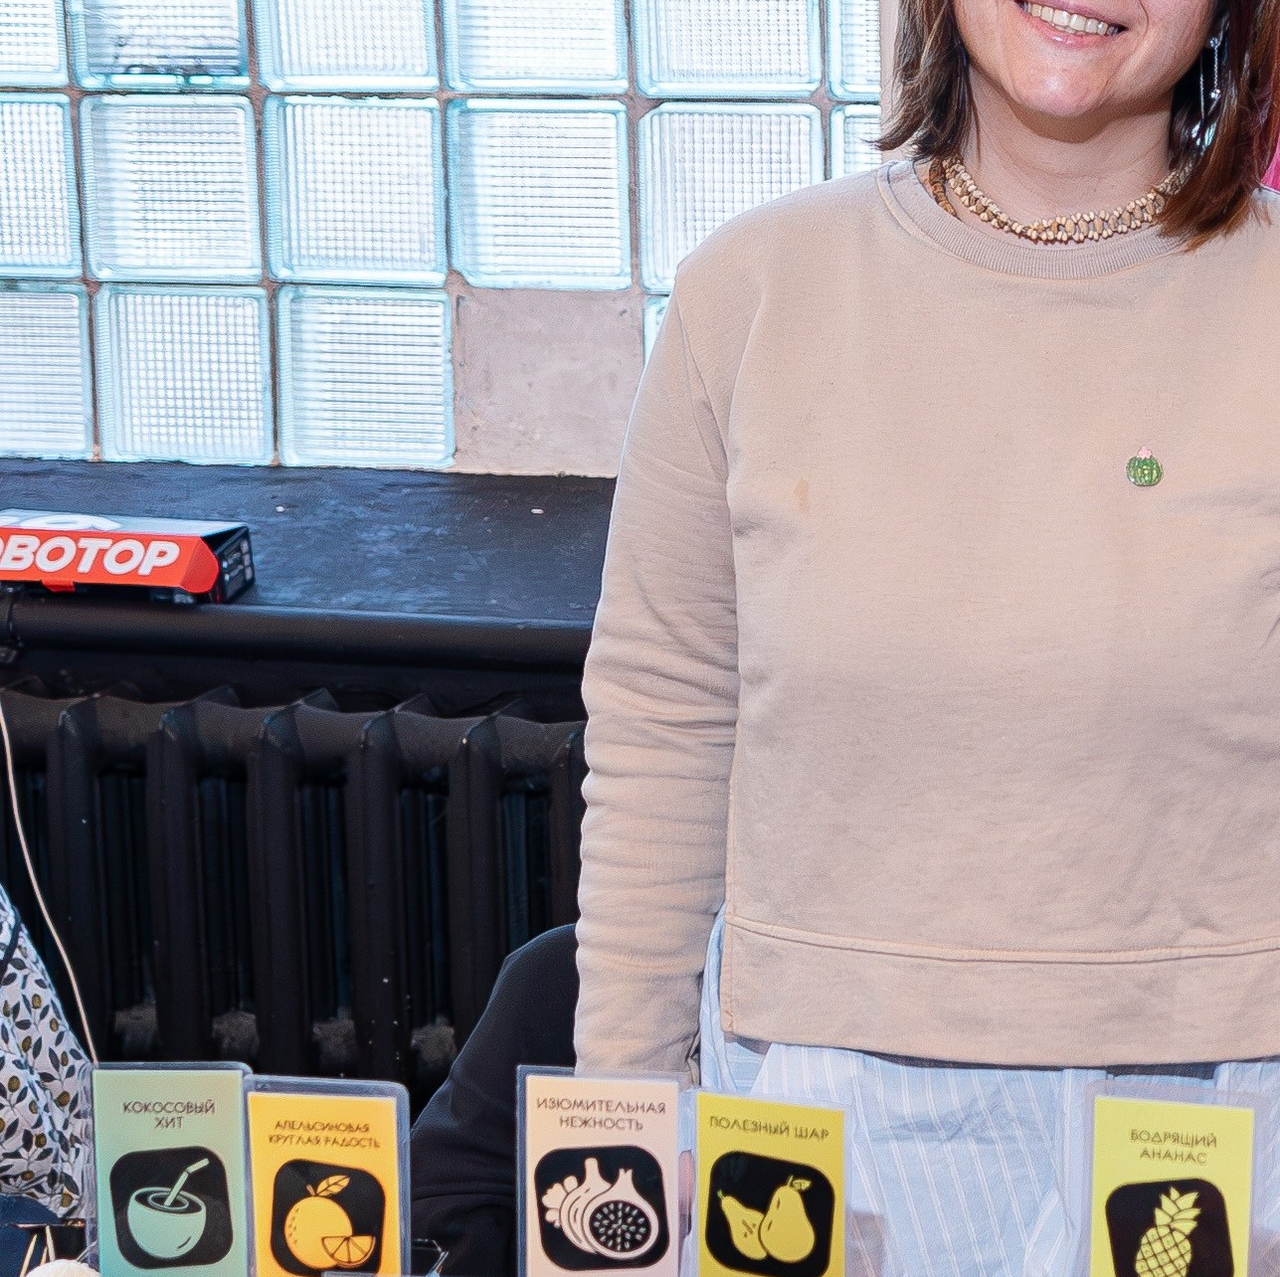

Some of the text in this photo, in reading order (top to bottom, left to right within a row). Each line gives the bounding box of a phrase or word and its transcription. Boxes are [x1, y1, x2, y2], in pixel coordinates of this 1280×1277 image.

[123, 1099, 215, 1114] КОКОСОВЫЙ
[536, 1096, 666, 1114] ИЗЮМИТЕЛЬНАЯ
[155, 1116, 184, 1129] ХИТ
[559, 1116, 644, 1131] НЕЖНОСТЬ
[710, 1115, 830, 1140] ПОЛЕЗНЫЙ ШАР
[1130, 1128, 1217, 1148] БОДРЯЩИЙ
[1139, 1147, 1208, 1165] АНАНАС
